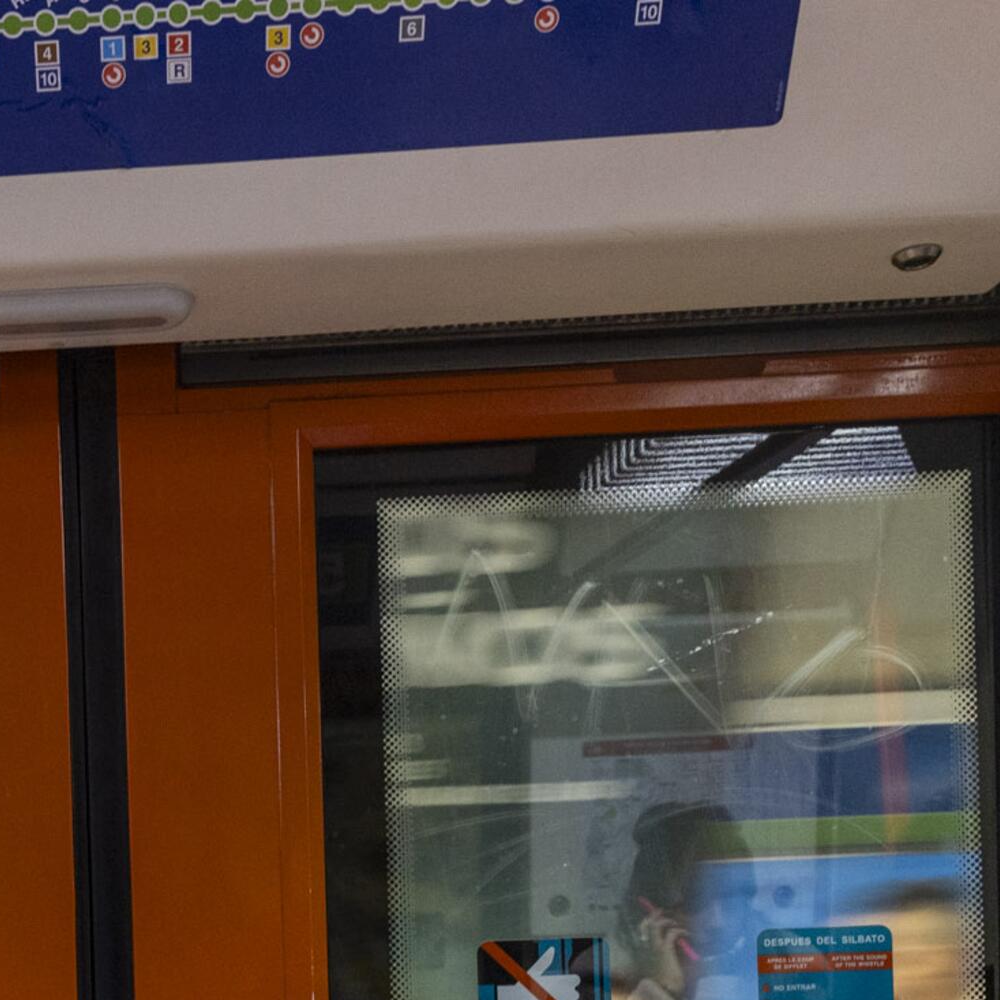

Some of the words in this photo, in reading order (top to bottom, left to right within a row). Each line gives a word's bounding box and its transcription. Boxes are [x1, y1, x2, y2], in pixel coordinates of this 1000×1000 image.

[640, 4, 658, 20] 10
[406, 21, 417, 36] 6
[174, 37, 184, 52] 2
[273, 30, 284, 46] 3
[42, 46, 52, 61] 4
[109, 42, 116, 56] 1
[141, 40, 151, 55] 3
[174, 63, 185, 78] R
[40, 71, 57, 87] 10
[816, 935, 837, 946] DEL
[841, 934, 886, 945] SILBATO
